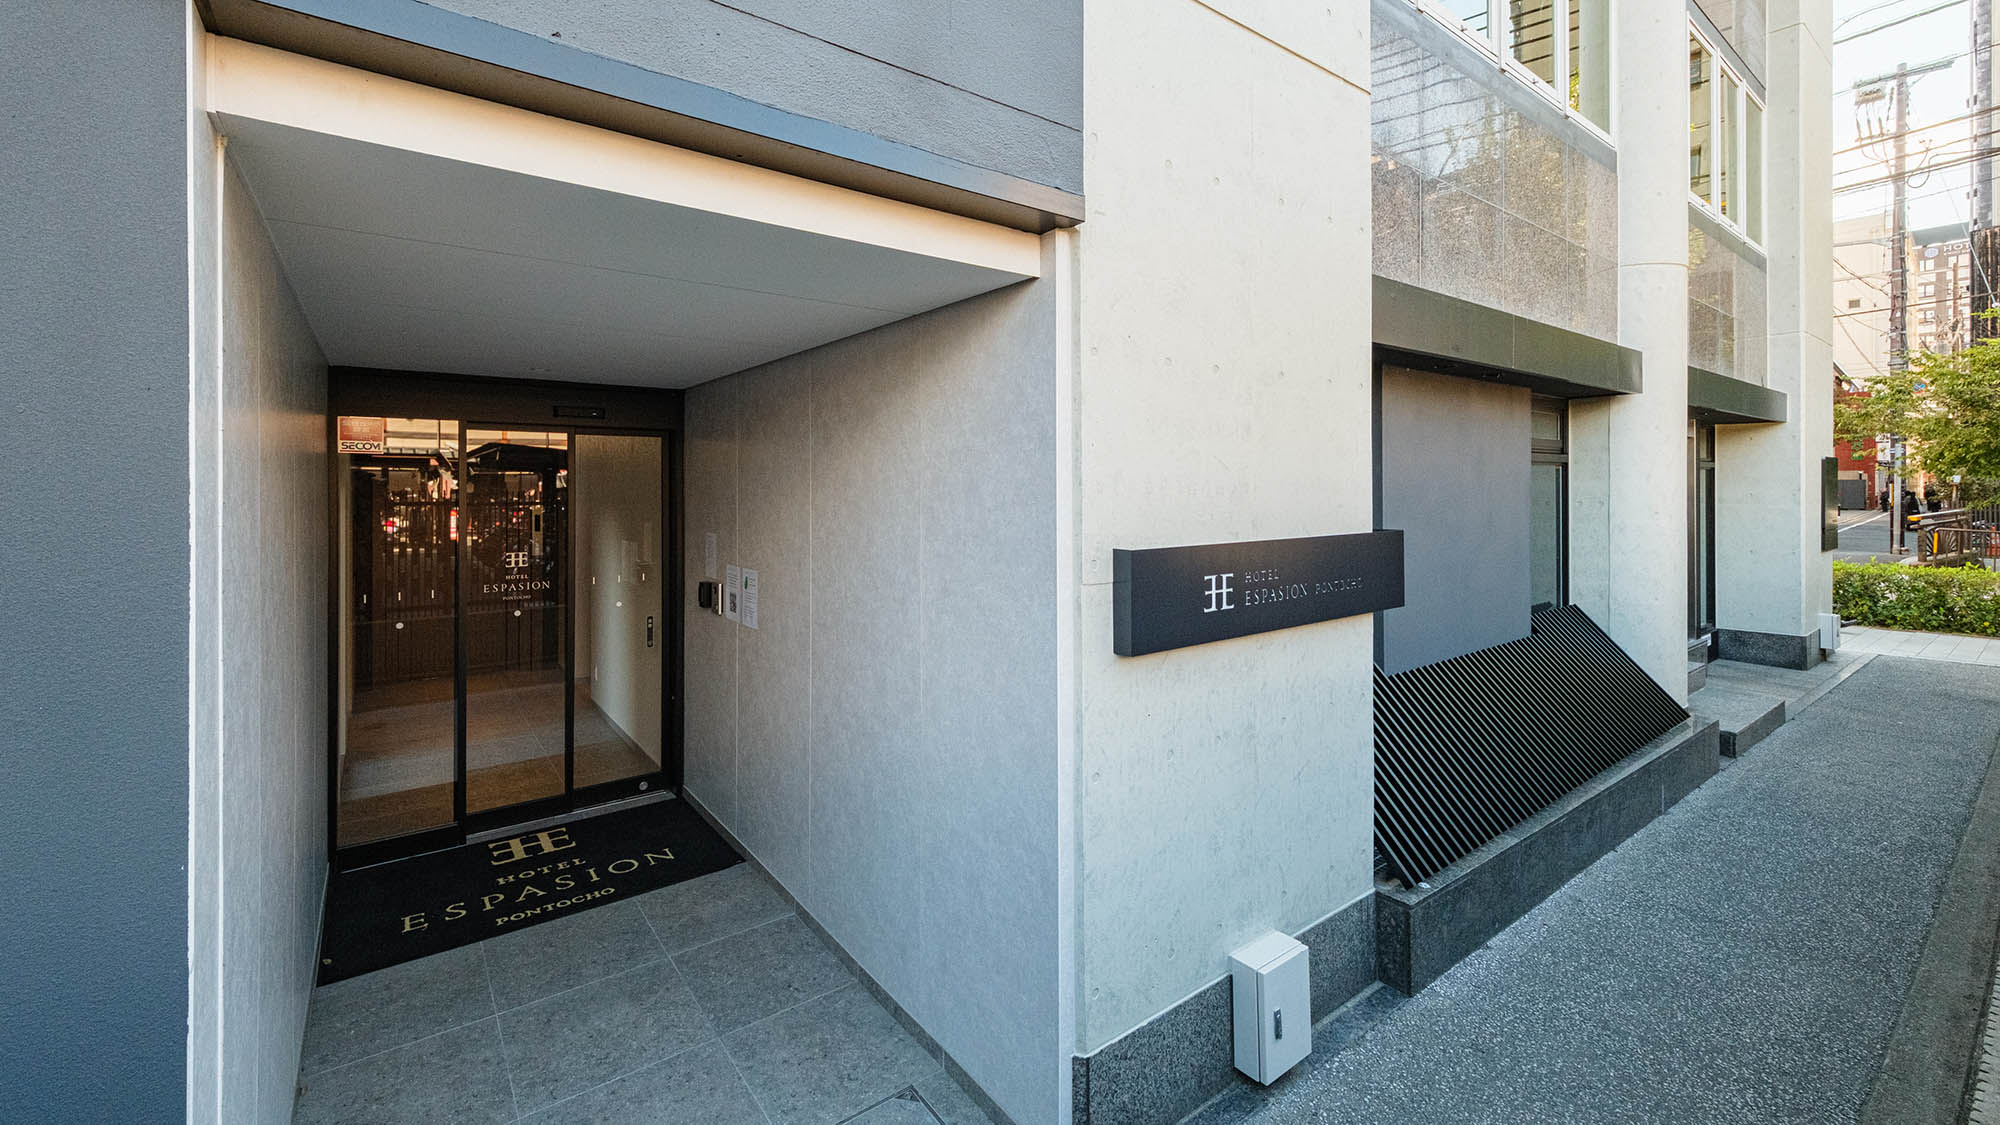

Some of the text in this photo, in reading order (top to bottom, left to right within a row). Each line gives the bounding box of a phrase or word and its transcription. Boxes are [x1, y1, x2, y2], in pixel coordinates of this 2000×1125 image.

[341, 441, 381, 450] SECOM
[483, 580, 550, 593] ESPASION
[1244, 568, 1280, 583] HOTEL
[1245, 582, 1309, 606] ESPASION
[495, 858, 586, 885] HOTEL
[401, 847, 675, 934] ESPASION
[495, 887, 616, 926] PONTOCHO
